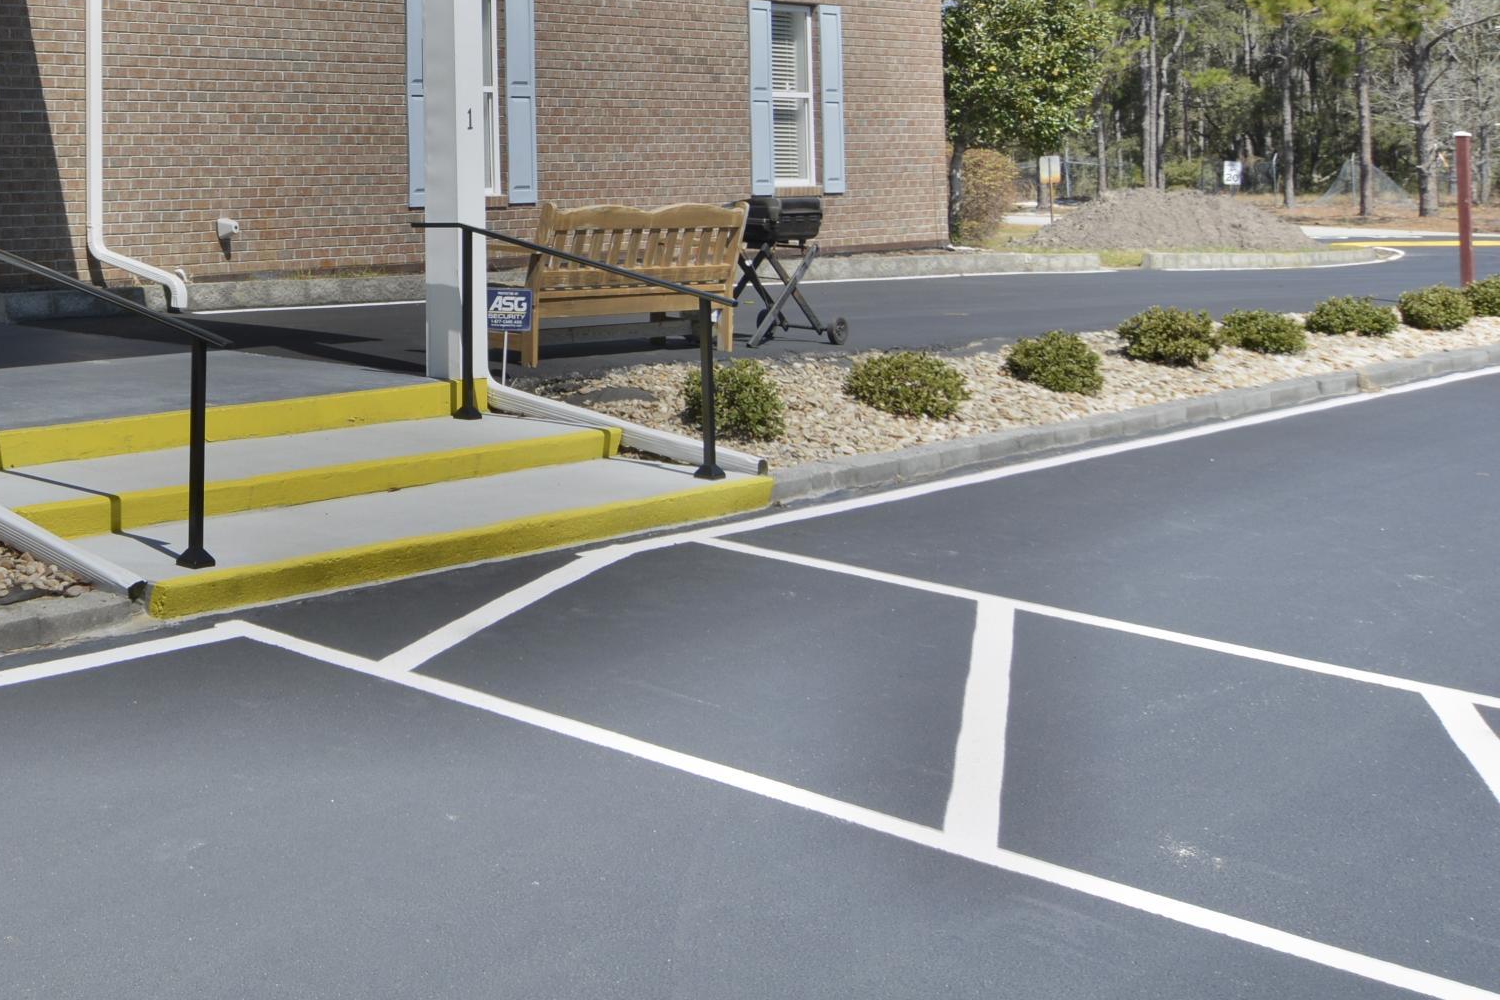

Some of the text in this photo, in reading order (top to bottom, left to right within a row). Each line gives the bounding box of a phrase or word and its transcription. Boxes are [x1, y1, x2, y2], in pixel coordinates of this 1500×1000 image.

[467, 107, 474, 130] 1
[1226, 173, 1239, 183] 20
[489, 295, 528, 312] ASG
